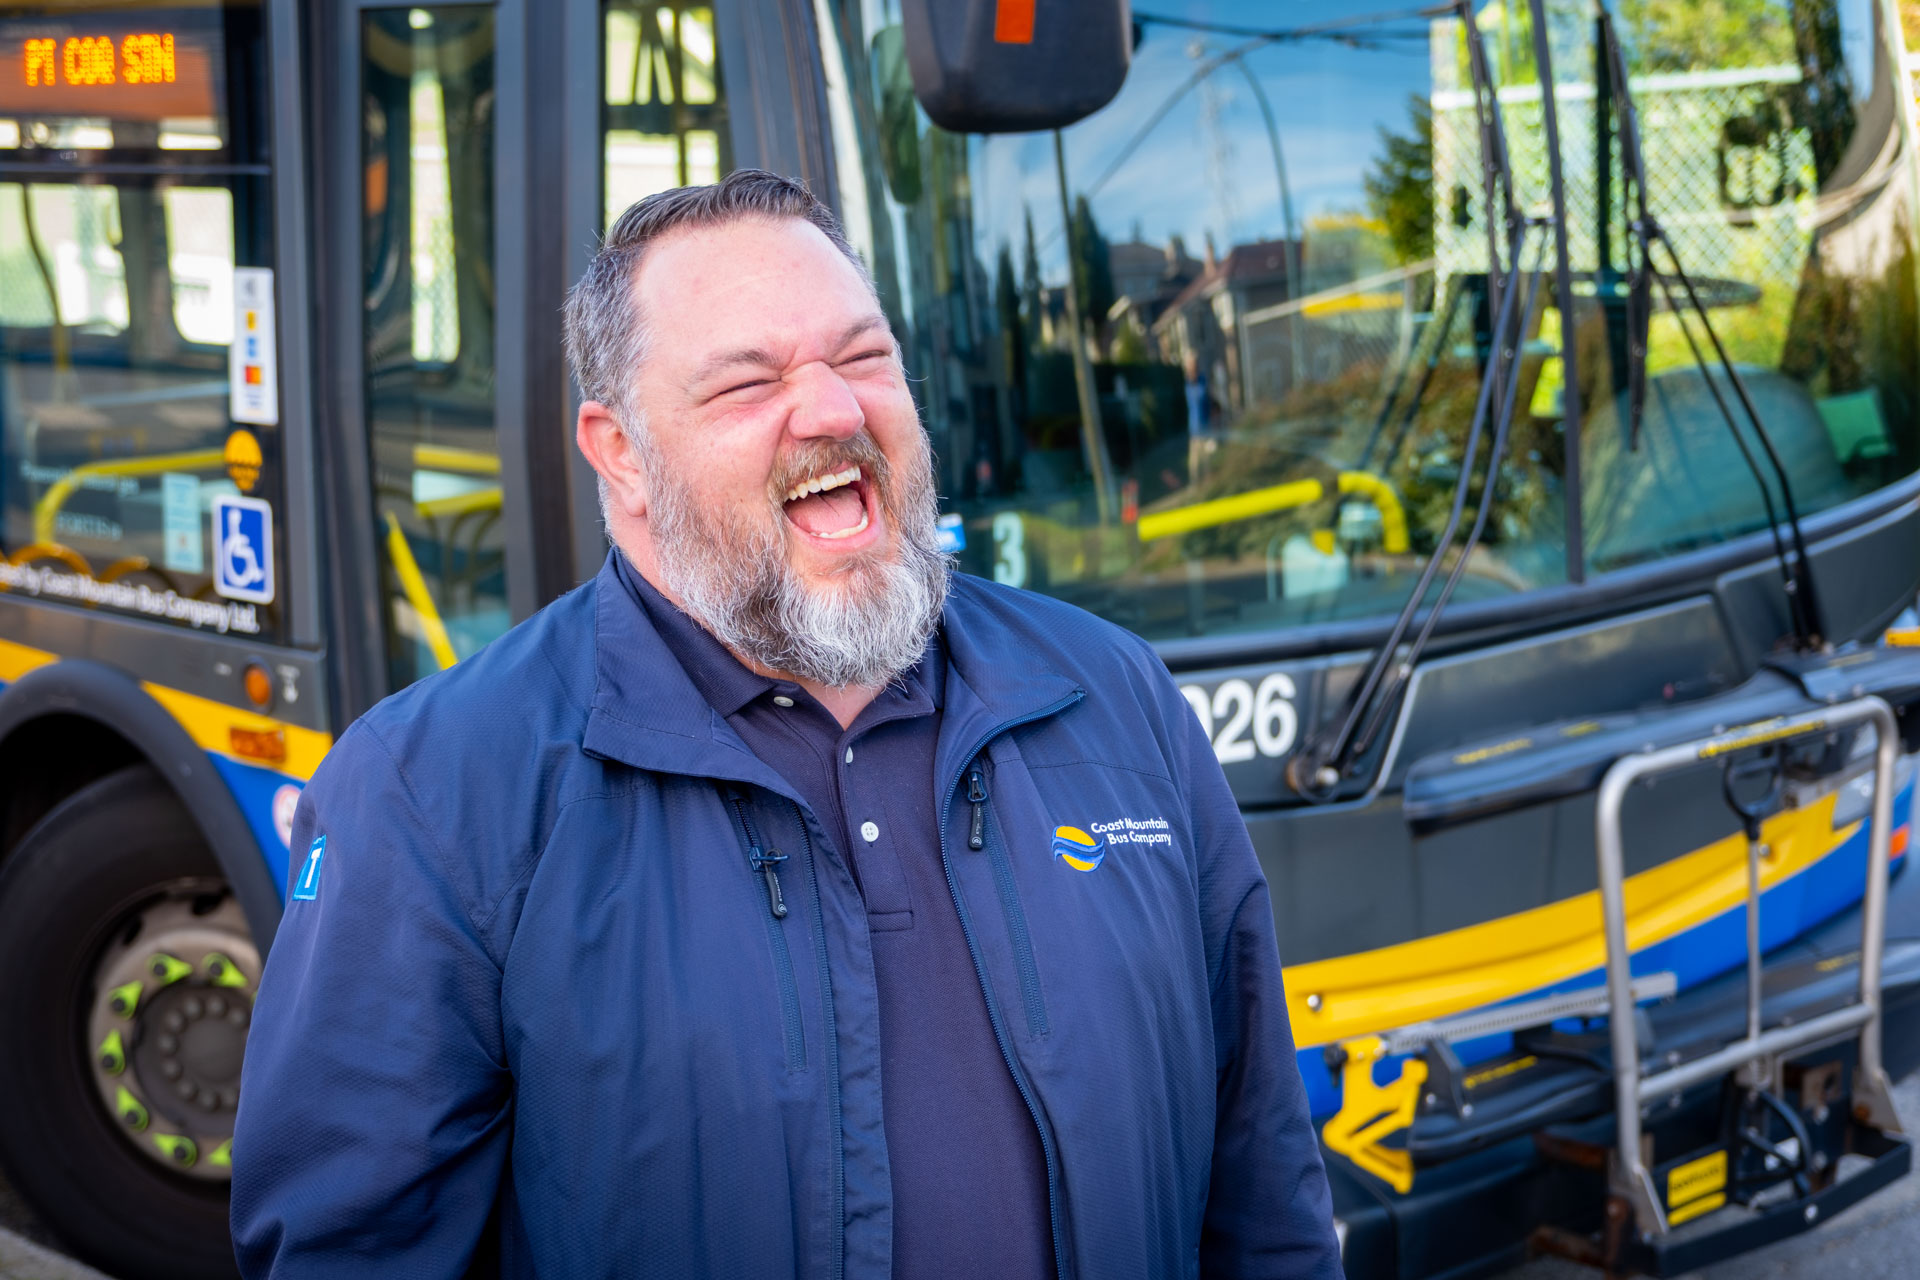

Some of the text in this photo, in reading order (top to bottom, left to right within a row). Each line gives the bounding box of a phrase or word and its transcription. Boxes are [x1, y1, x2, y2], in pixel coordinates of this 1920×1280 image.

[121, 33, 176, 84] STN
[992, 511, 1027, 589] 3
[1090, 816, 1169, 834] Coast Mountain
[1106, 830, 1171, 847] Bus Company
